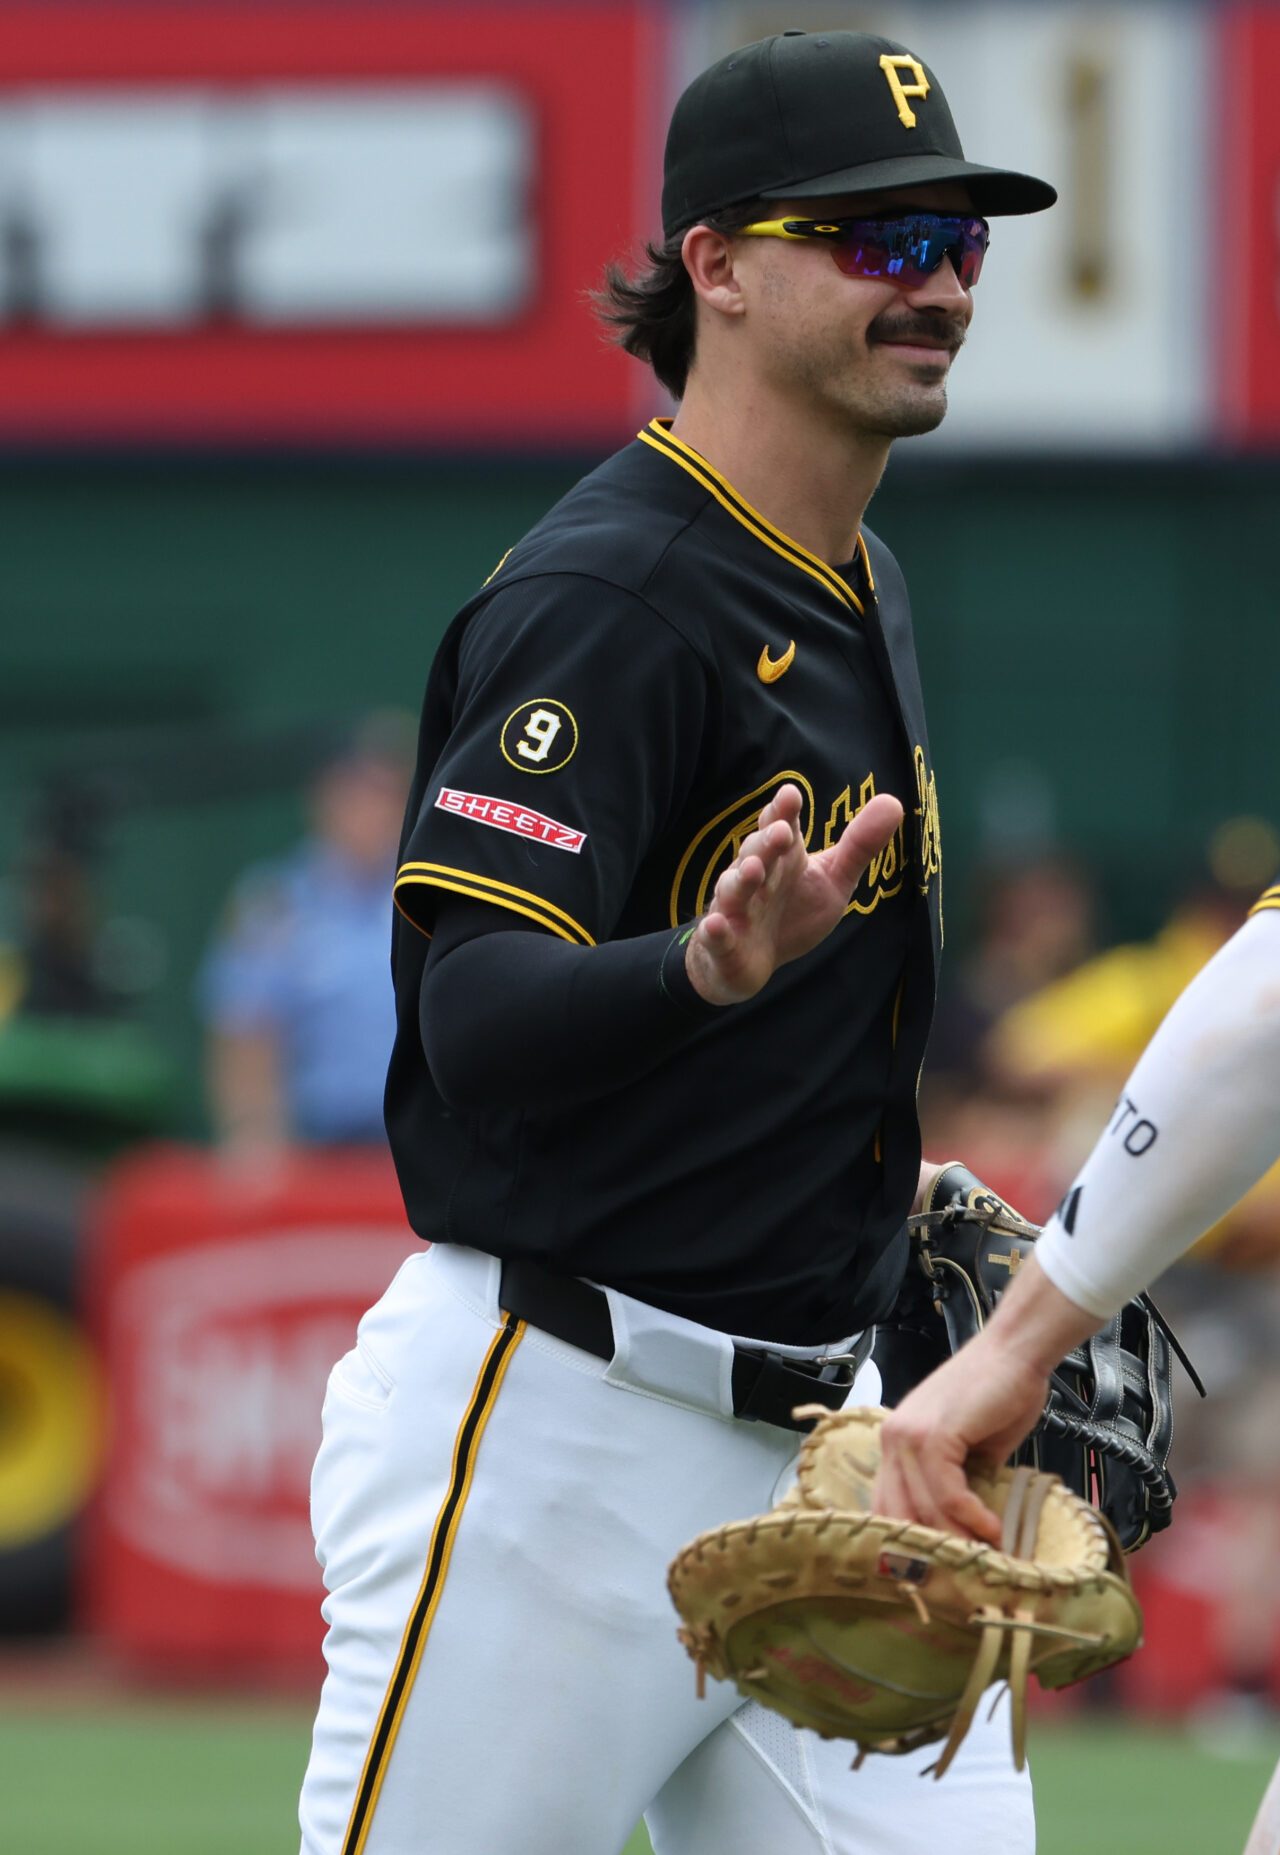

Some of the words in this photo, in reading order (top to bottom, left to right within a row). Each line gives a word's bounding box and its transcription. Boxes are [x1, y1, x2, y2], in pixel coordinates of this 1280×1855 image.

[879, 53, 930, 129] P
[516, 708, 562, 763] 9
[443, 792, 579, 848] SHEETZ
[1110, 1096, 1159, 1158] TO
